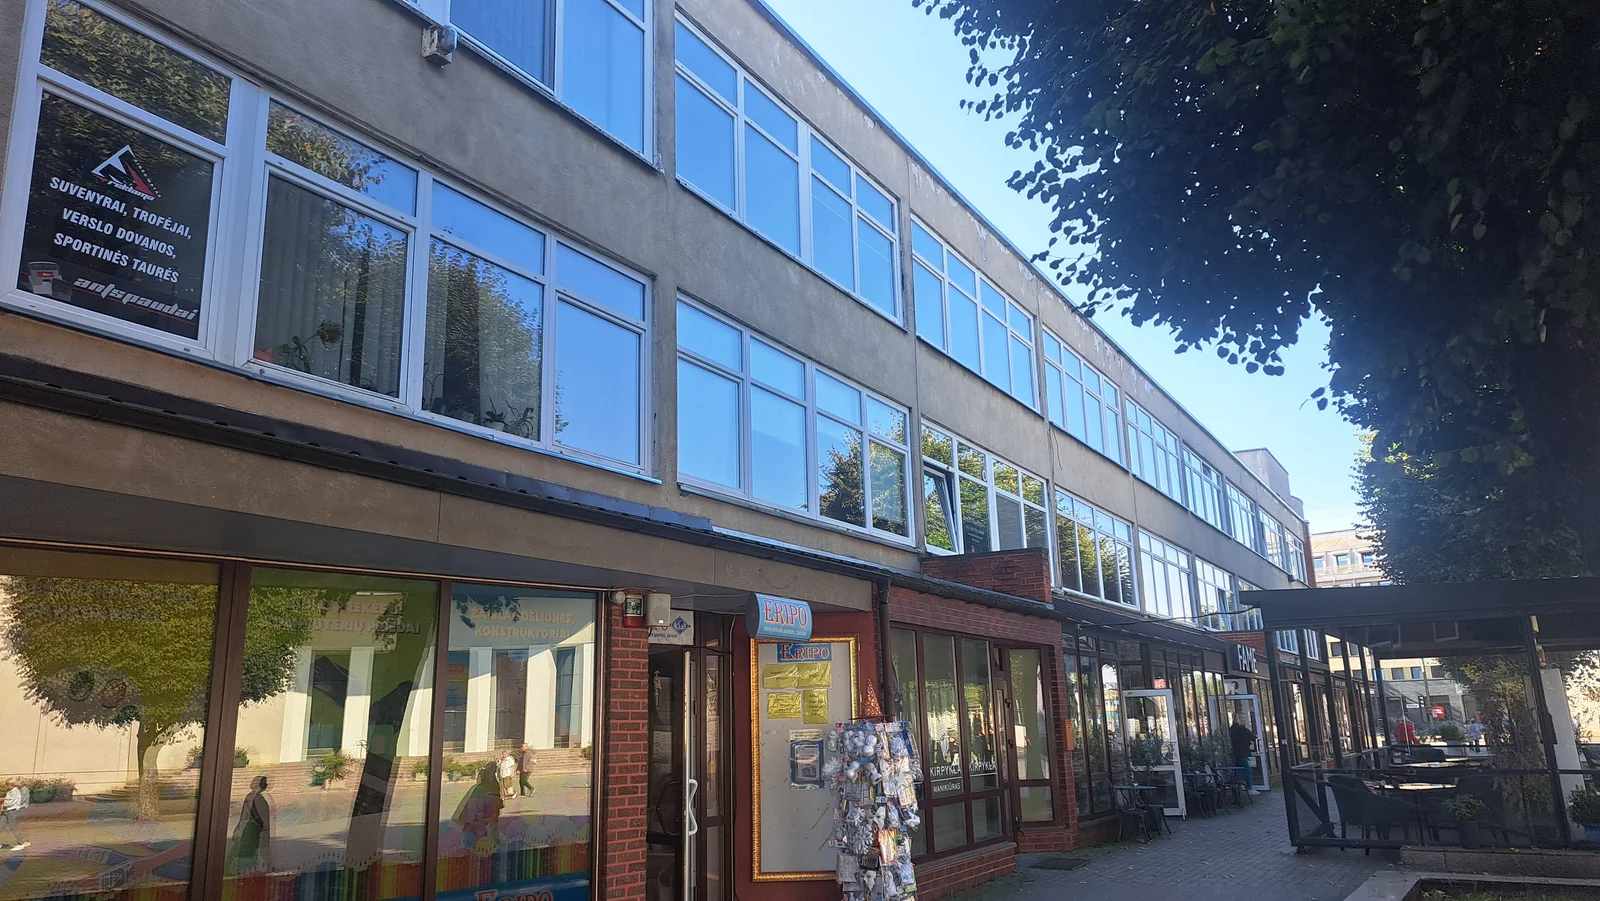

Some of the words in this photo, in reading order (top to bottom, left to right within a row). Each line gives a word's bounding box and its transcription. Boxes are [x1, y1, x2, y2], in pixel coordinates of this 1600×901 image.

[50, 177, 128, 216] SUVENYRAI,
[133, 207, 192, 240] TROFĖJAI,
[62, 208, 114, 235] VERSLO
[116, 228, 177, 259] DOVANOS,
[53, 233, 129, 267] SPORTINĖS
[132, 258, 179, 283] TAURĖS
[763, 599, 809, 628] ERIPO
[929, 764, 961, 777] KIRPYKLA
